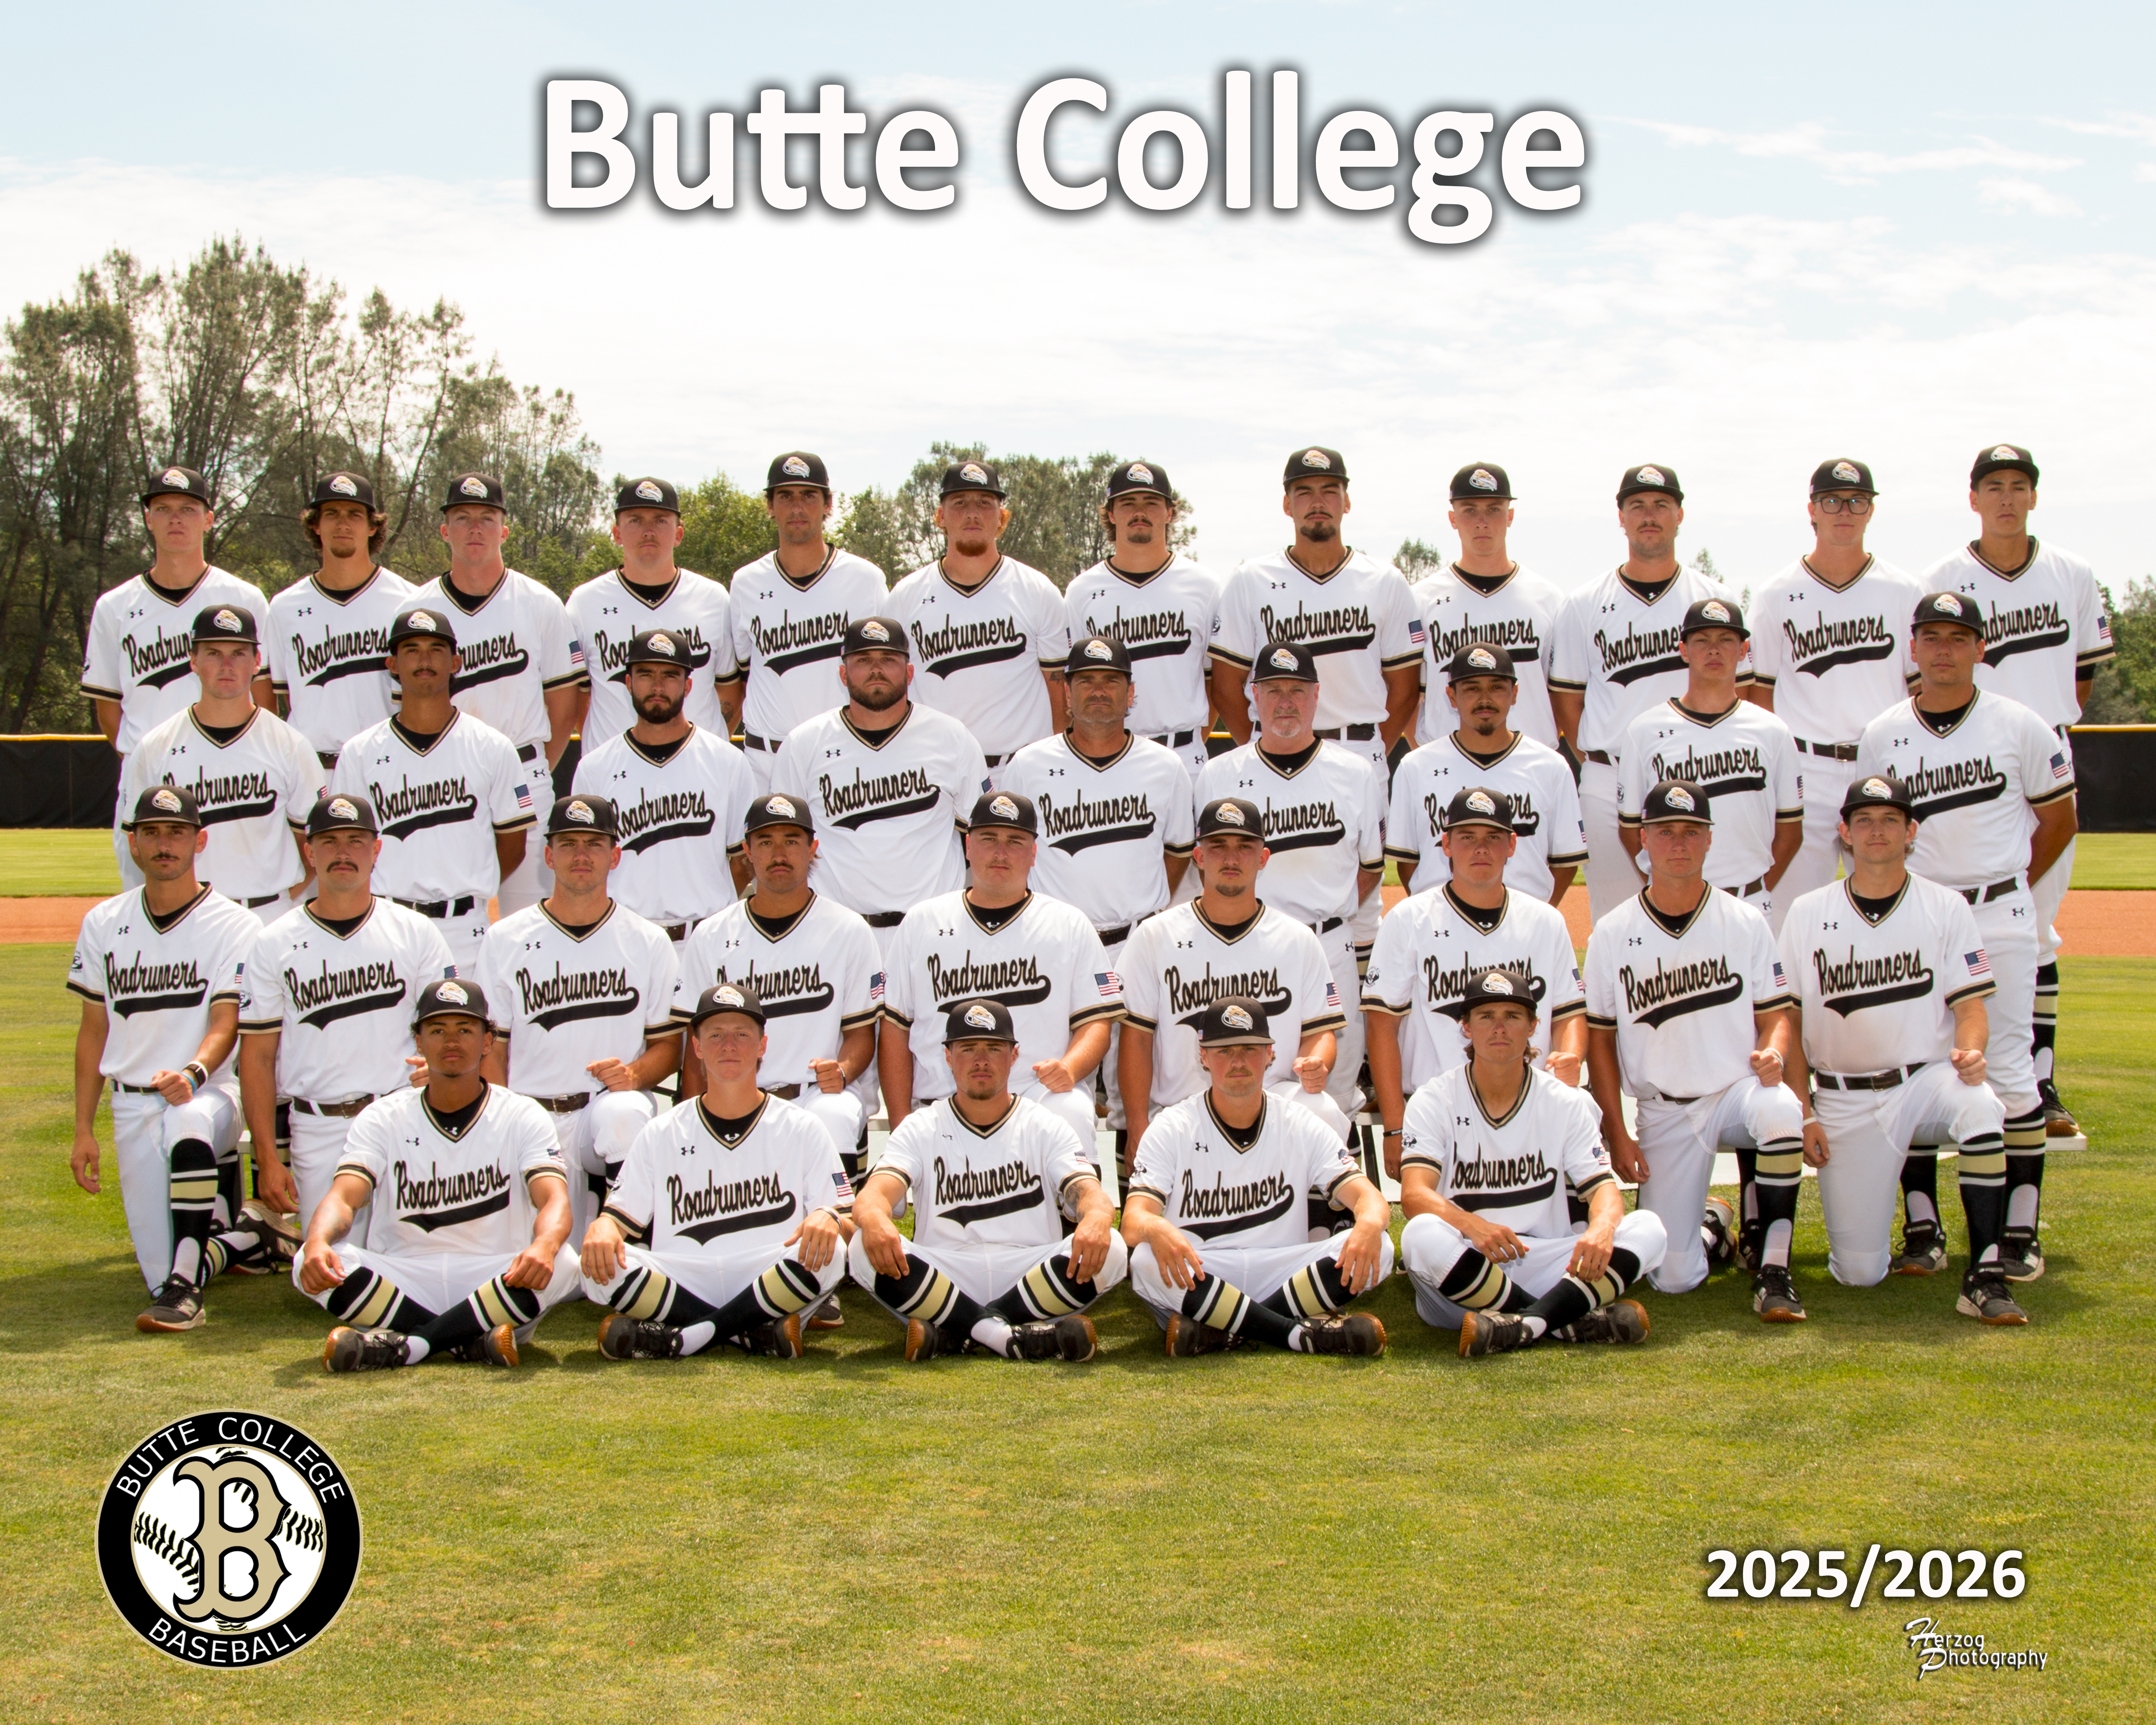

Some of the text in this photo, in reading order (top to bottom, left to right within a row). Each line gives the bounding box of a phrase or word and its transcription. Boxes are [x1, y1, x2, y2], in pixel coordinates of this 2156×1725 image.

[751, 609, 848, 656] Roadrunners
[911, 613, 1017, 663] Roadrunners
[1261, 601, 1368, 644] Roadrunners
[1429, 613, 1534, 663] Roadrunners
[1593, 621, 1683, 672] Roadrunne
[1783, 611, 1883, 662] Roadrunners
[1982, 601, 2062, 646] adrunners
[122, 626, 192, 677] Roadrun
[292, 624, 392, 677] Roadrunners
[457, 630, 518, 673] runners
[819, 766, 927, 817] Roadrunners
[1039, 789, 1148, 837] Roadrunners
[1263, 796, 1339, 837] drunners
[284, 959, 399, 1015] Roadrunners
[516, 961, 627, 1015] Roadrunners
[926, 948, 1036, 1002] Roadrunners
[1163, 961, 1280, 1015] Roadrunners
[1620, 954, 1730, 1015] Roadrunners
[1813, 944, 1921, 996] Roadrunners
[395, 1158, 507, 1210] Roadrunners
[934, 1154, 1033, 1205] Roadrunners
[1451, 1141, 1545, 1189] oadrunners
[668, 1169, 782, 1224] Roadrunners
[1179, 1167, 1288, 1218] Roadrunners
